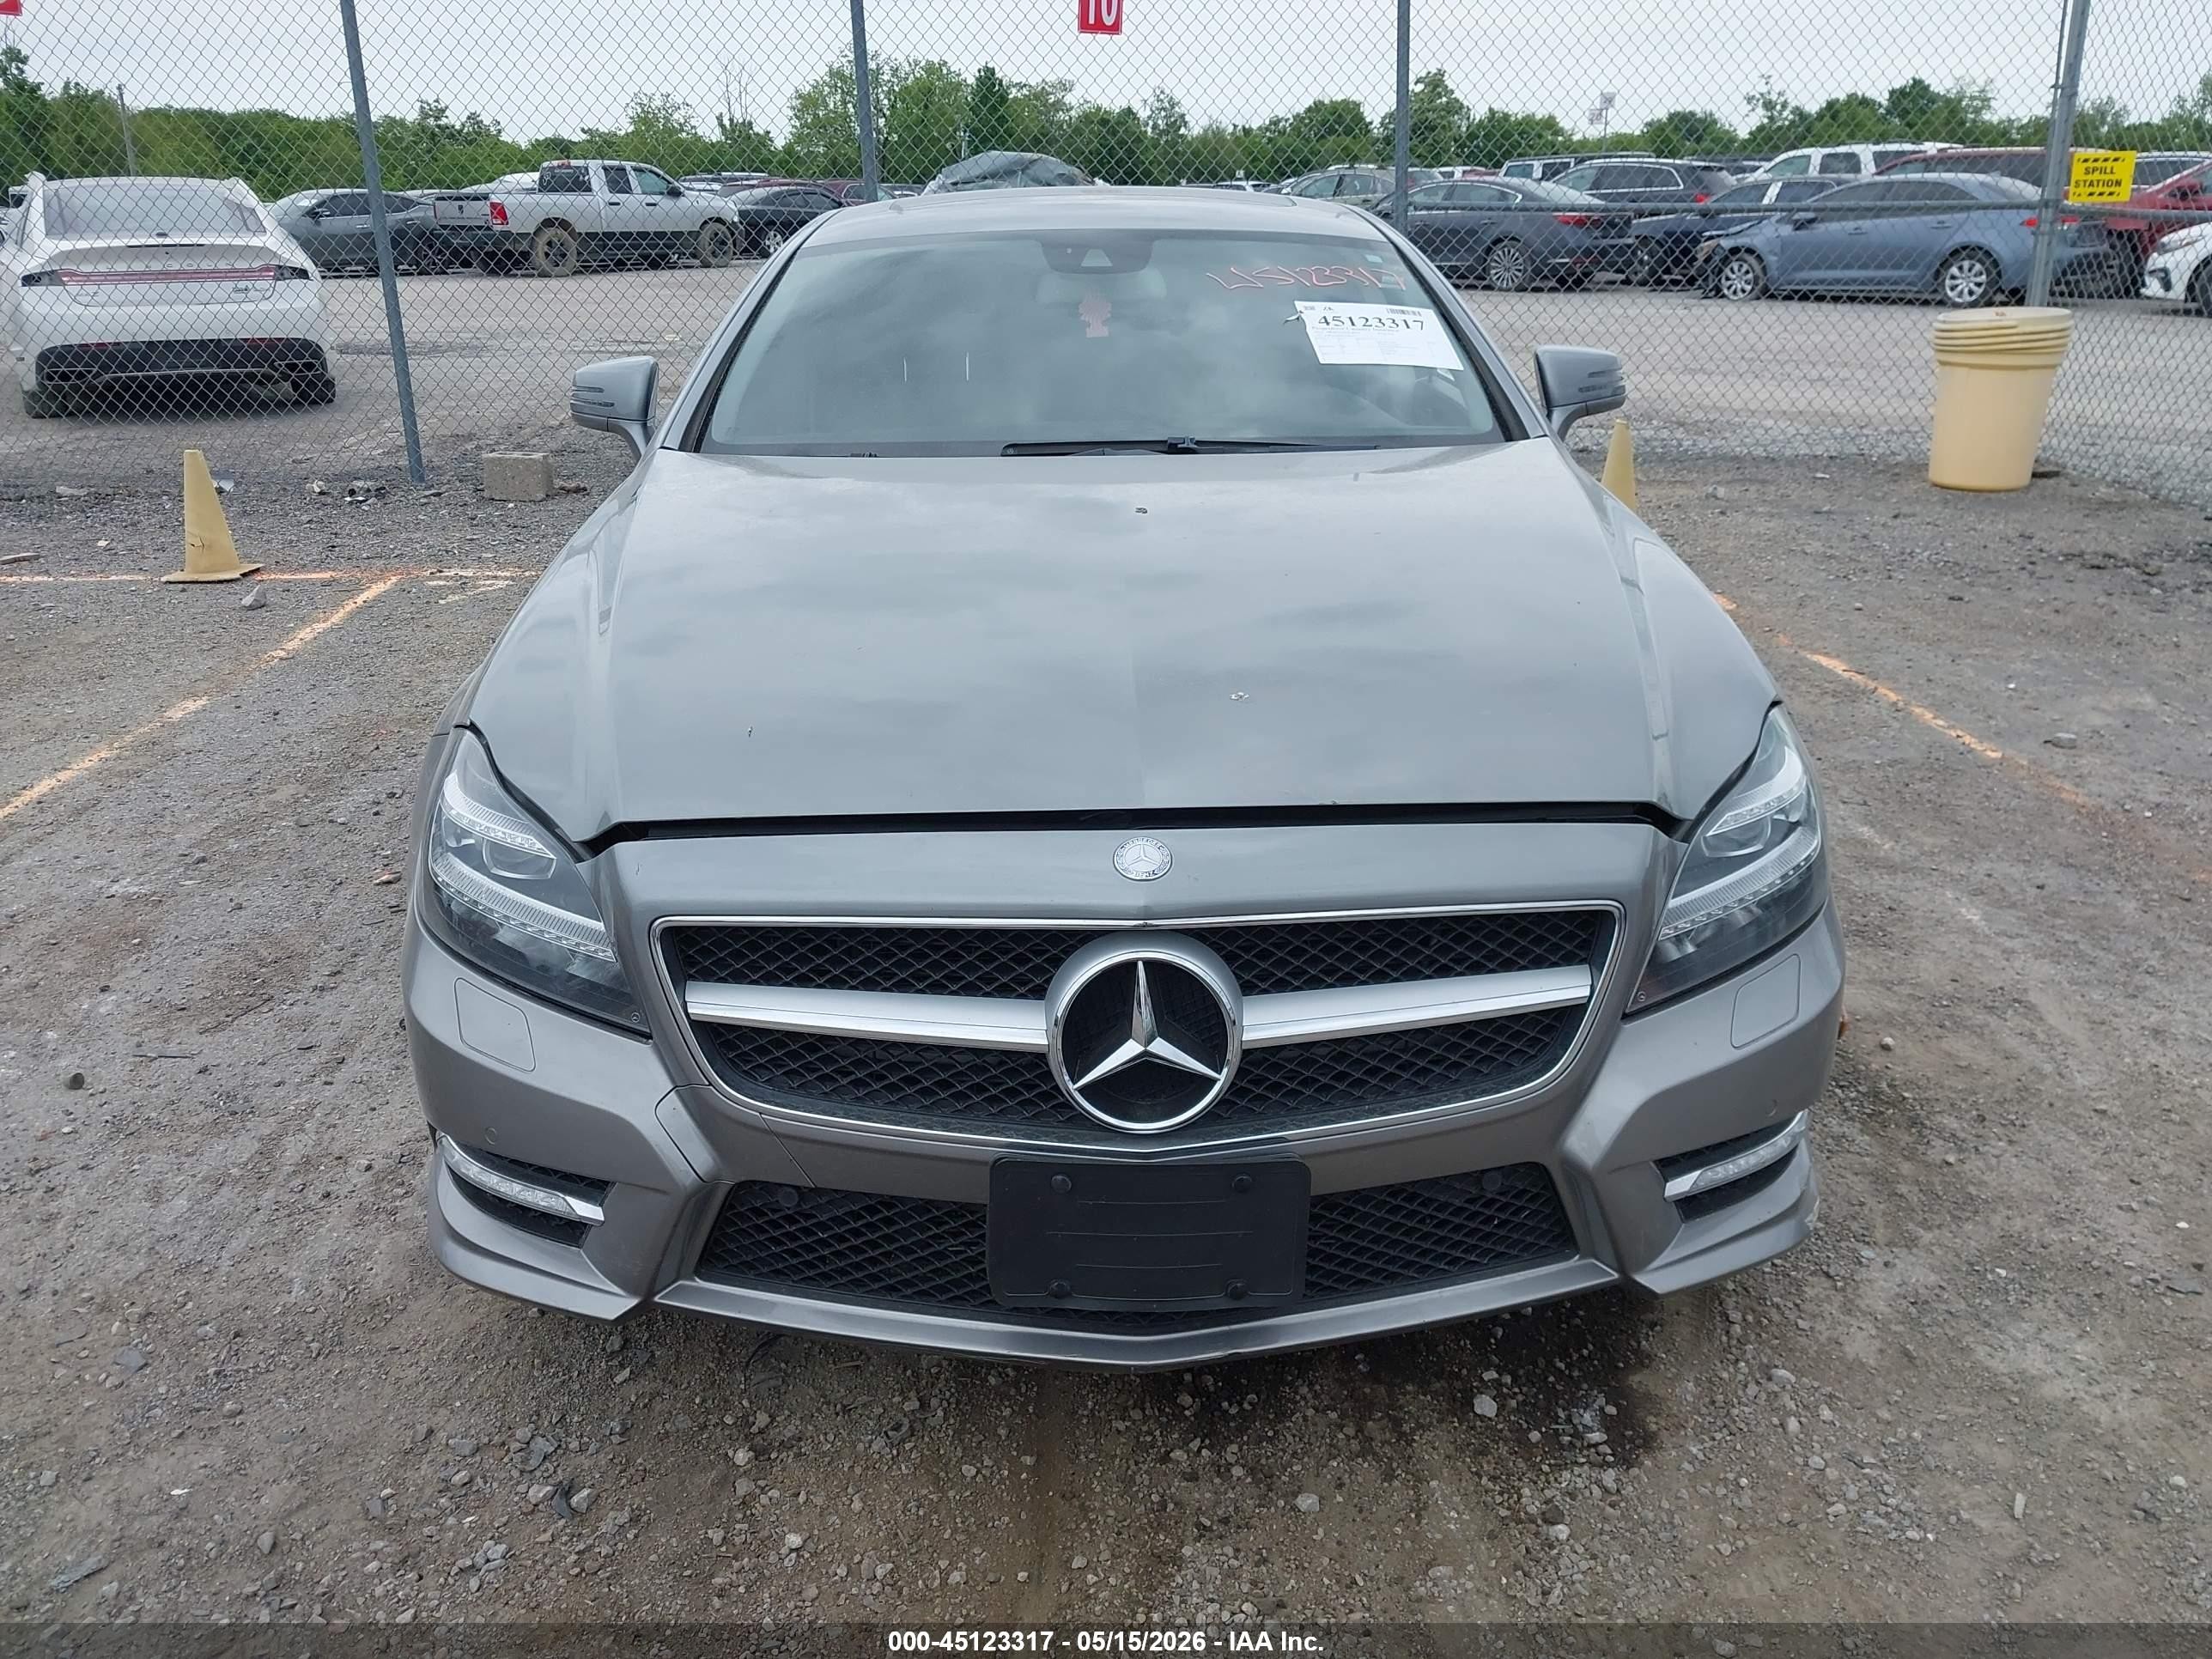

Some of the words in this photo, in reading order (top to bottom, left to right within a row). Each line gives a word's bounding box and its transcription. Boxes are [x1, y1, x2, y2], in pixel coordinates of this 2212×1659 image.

[2083, 166, 2116, 175] SPILL
[2074, 179, 2122, 189] STATION
[1318, 315, 1424, 331] 45123317
